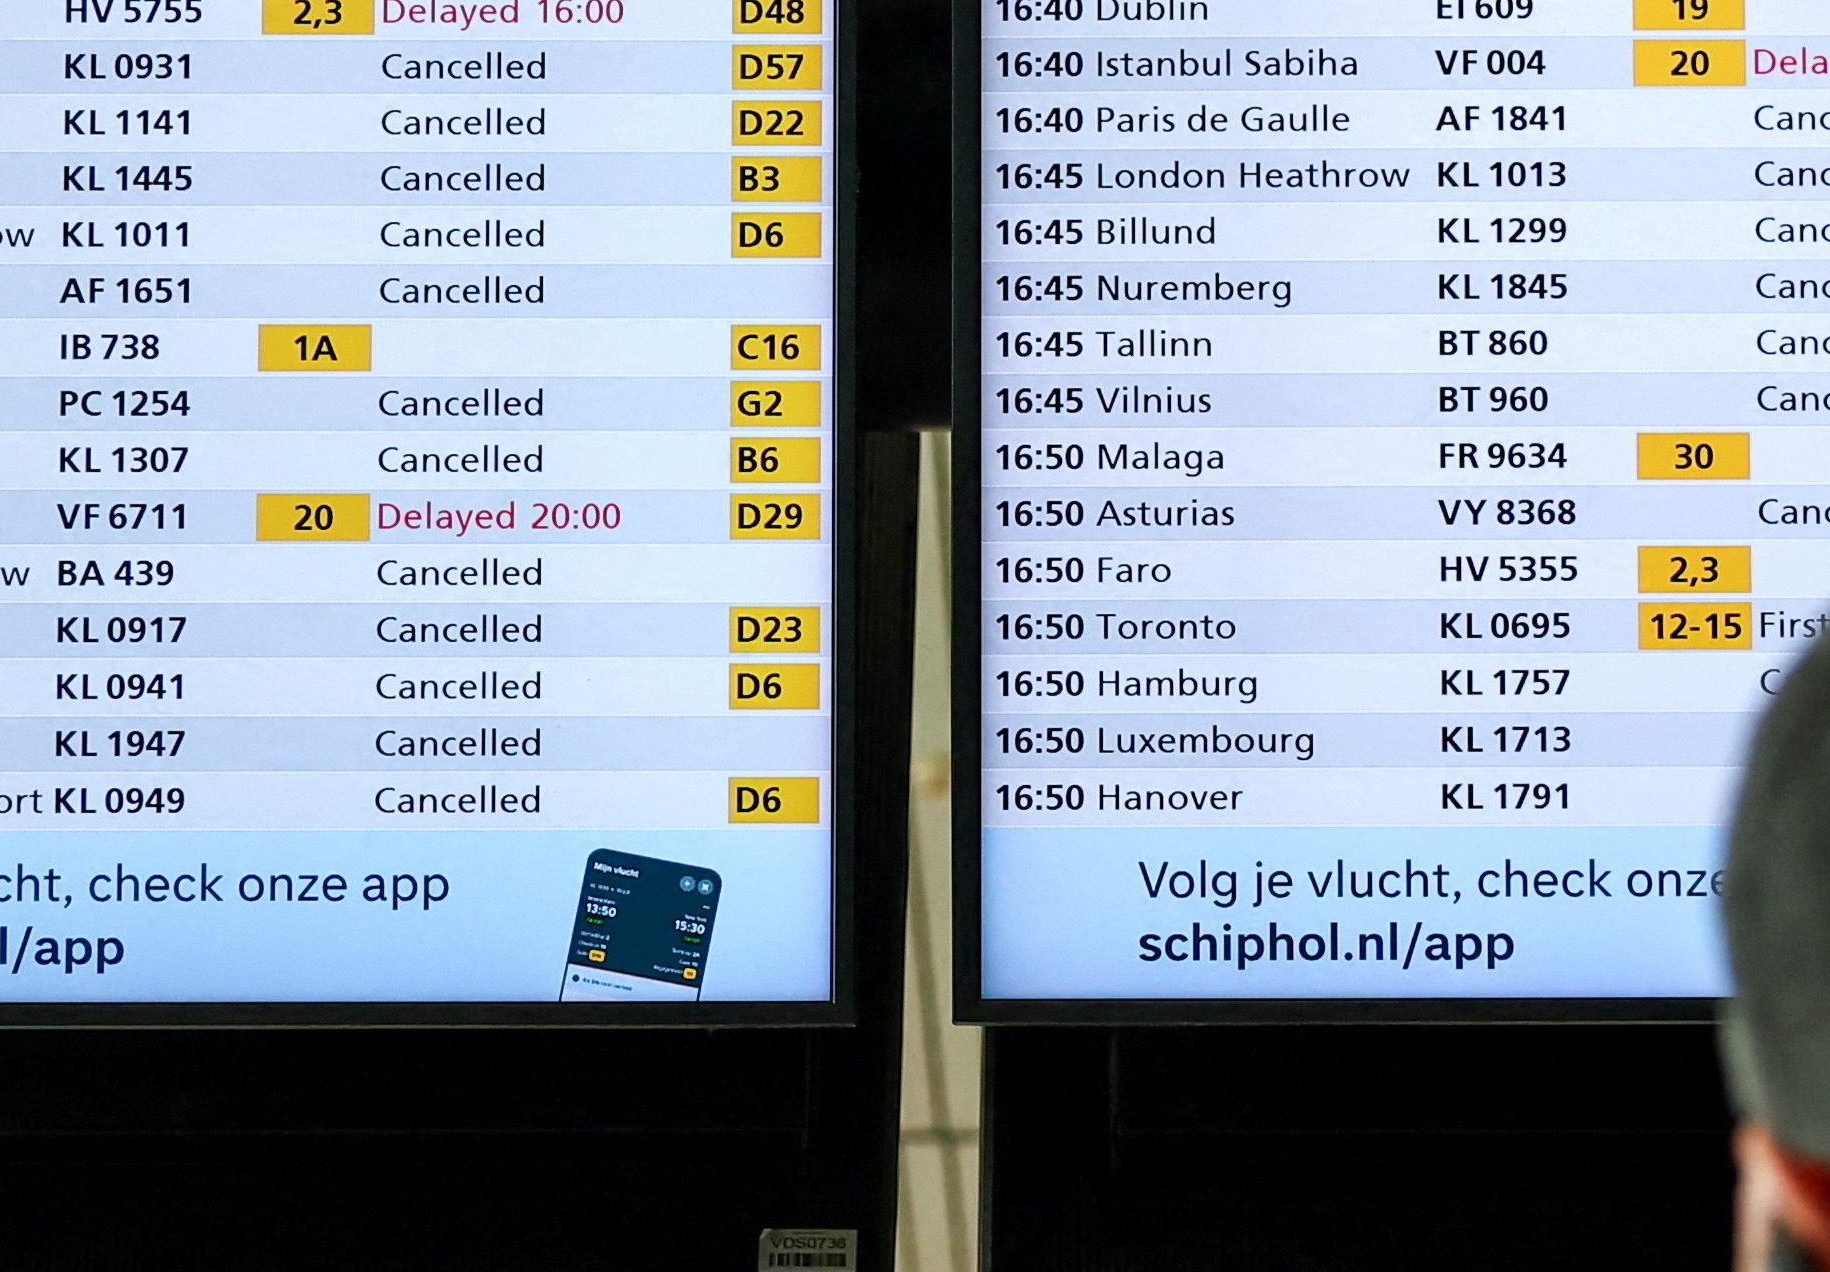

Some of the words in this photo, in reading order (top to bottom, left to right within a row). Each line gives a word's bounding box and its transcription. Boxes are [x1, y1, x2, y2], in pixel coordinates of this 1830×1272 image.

[994, 442, 1086, 472] 16:50
[1096, 440, 1225, 479] Malaga
[1438, 441, 1481, 470] FR
[1485, 441, 1569, 470] 9634
[1673, 442, 1715, 471] 30
[54, 729, 99, 758] KL
[106, 728, 187, 758] 1947
[373, 726, 542, 758] Cancelled
[586, 902, 617, 918] 13:50
[675, 919, 706, 935] 15:30
